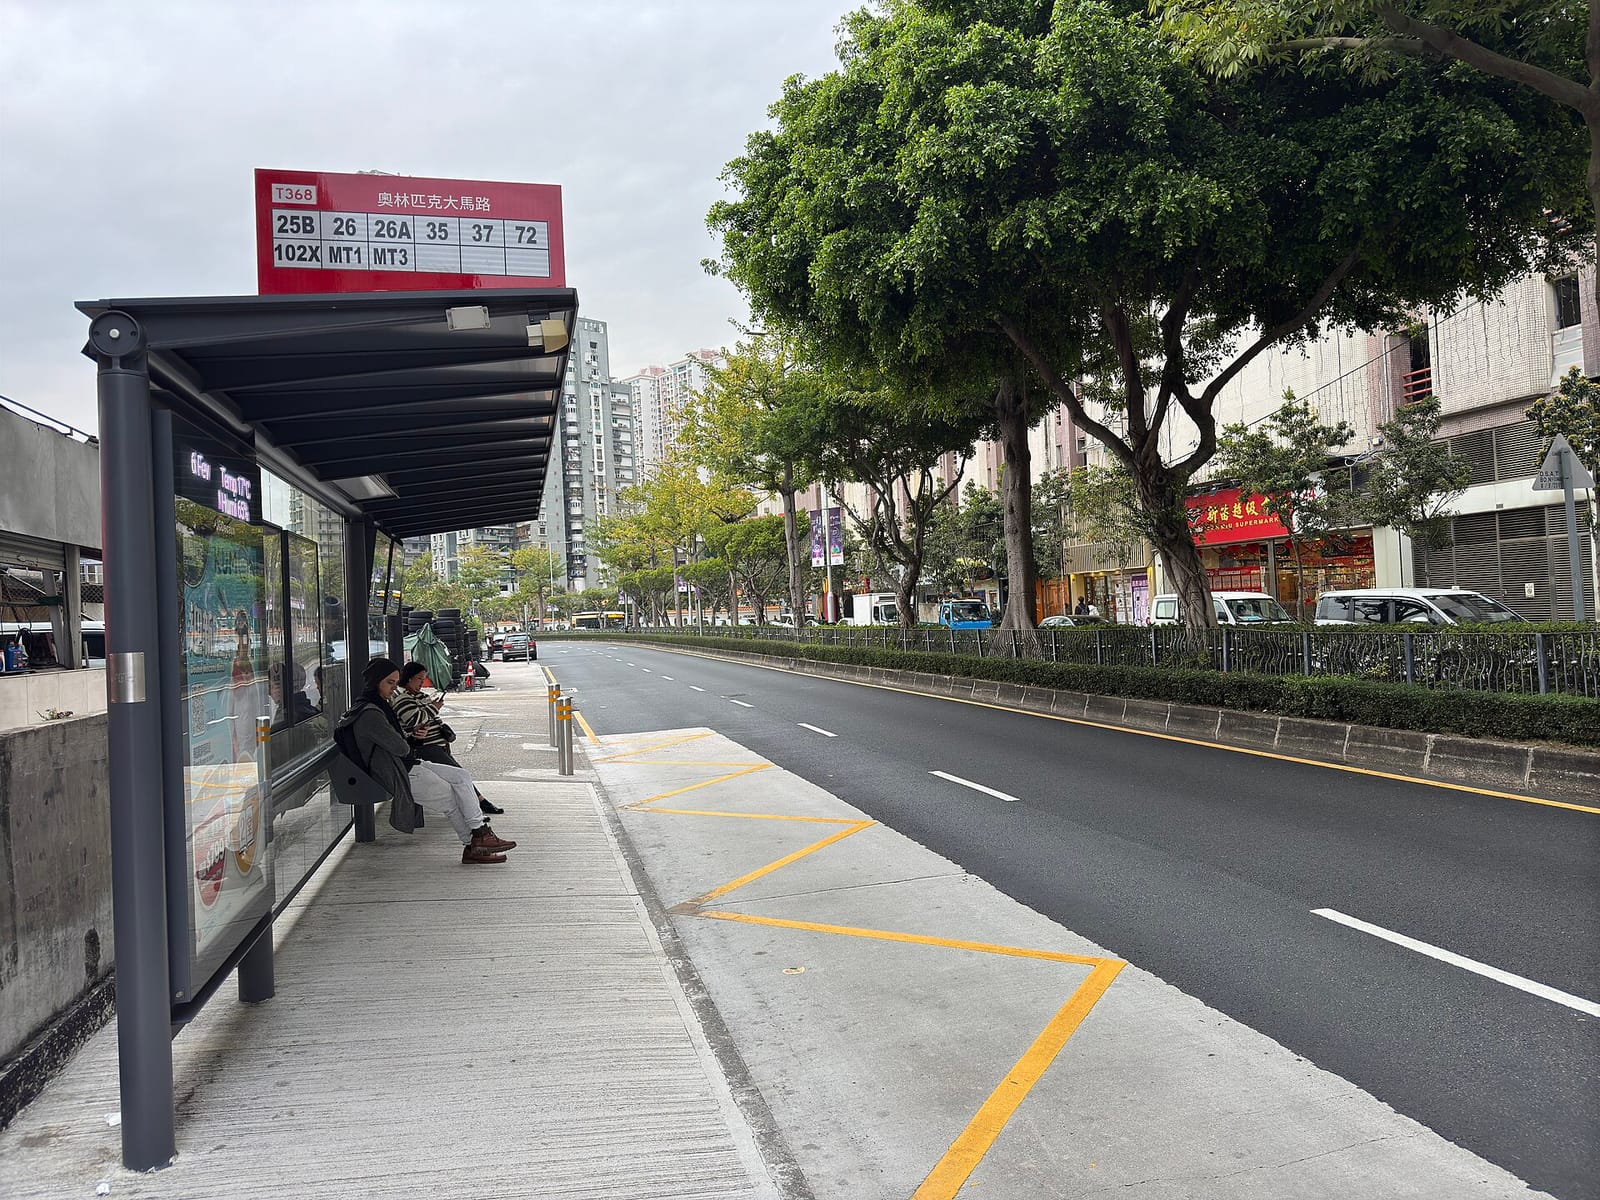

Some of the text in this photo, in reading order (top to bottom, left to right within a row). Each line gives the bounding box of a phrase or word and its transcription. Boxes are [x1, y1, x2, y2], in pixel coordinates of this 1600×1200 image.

[275, 187, 313, 200] T368
[377, 192, 491, 212] 奧林匹克大馬路
[277, 215, 537, 244] 25B 26 26A 35 37 72
[274, 243, 408, 265] 102X MT1 MT3
[1235, 517, 1279, 528] SUPERMARK
